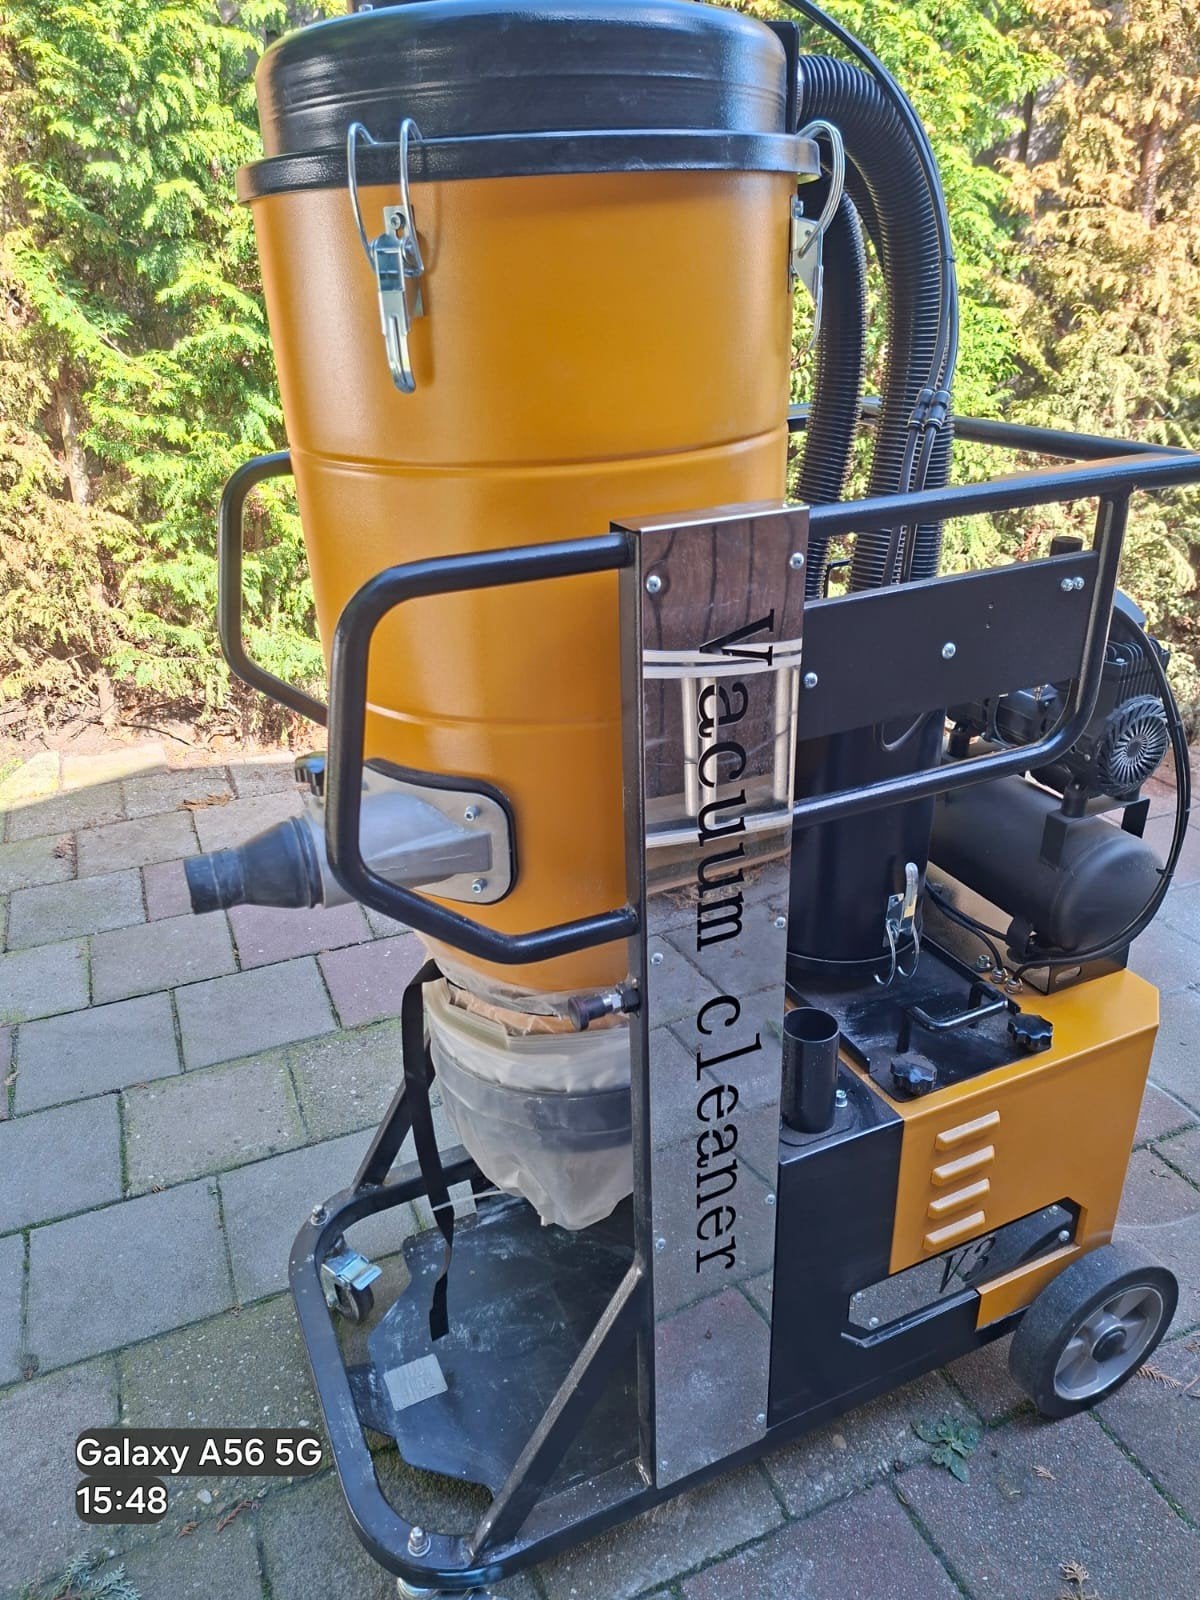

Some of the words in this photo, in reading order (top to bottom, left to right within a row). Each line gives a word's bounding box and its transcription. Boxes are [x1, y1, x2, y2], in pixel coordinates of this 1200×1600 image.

[698, 608, 775, 952] Vacuum
[696, 994, 762, 1273] cleaner
[938, 1236, 996, 1294] V3
